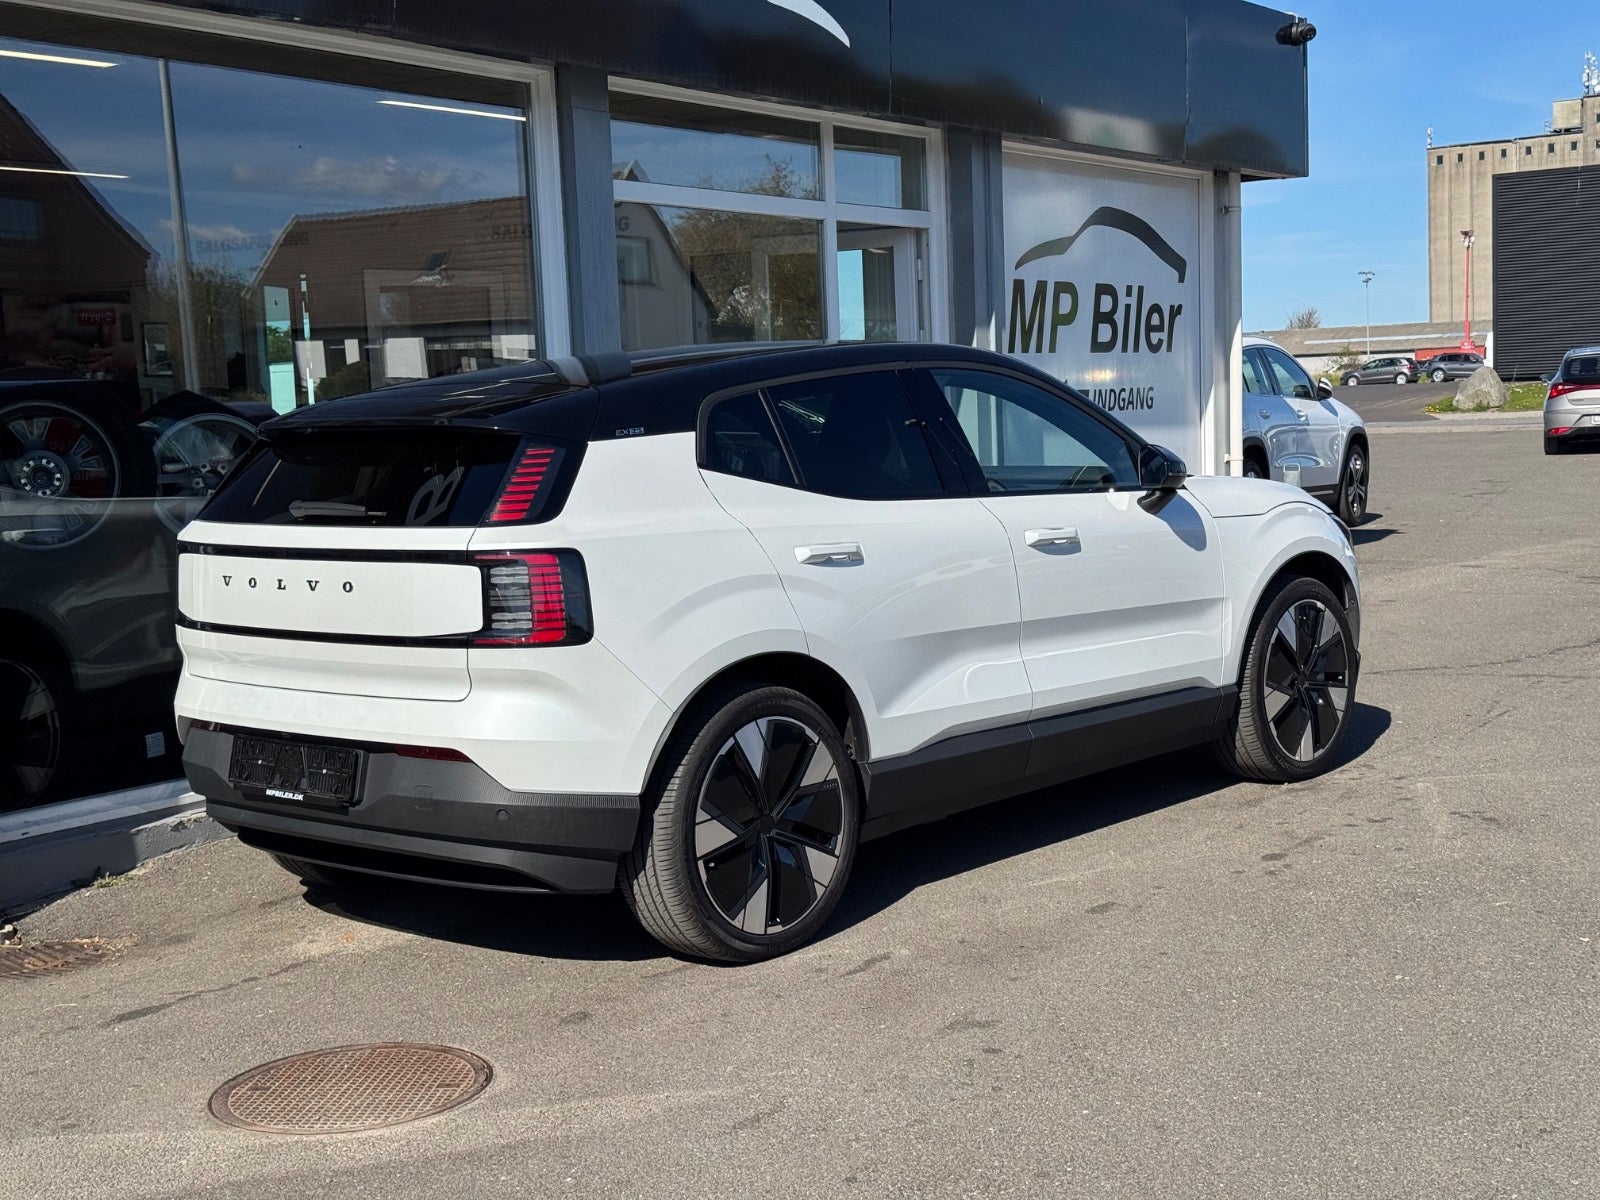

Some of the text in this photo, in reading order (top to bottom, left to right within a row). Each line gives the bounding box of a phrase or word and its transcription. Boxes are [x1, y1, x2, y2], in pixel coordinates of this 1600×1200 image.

[1008, 279, 1183, 354] MP Biler
[1094, 386, 1154, 411] INDGANG
[222, 575, 354, 593] VOLVO
